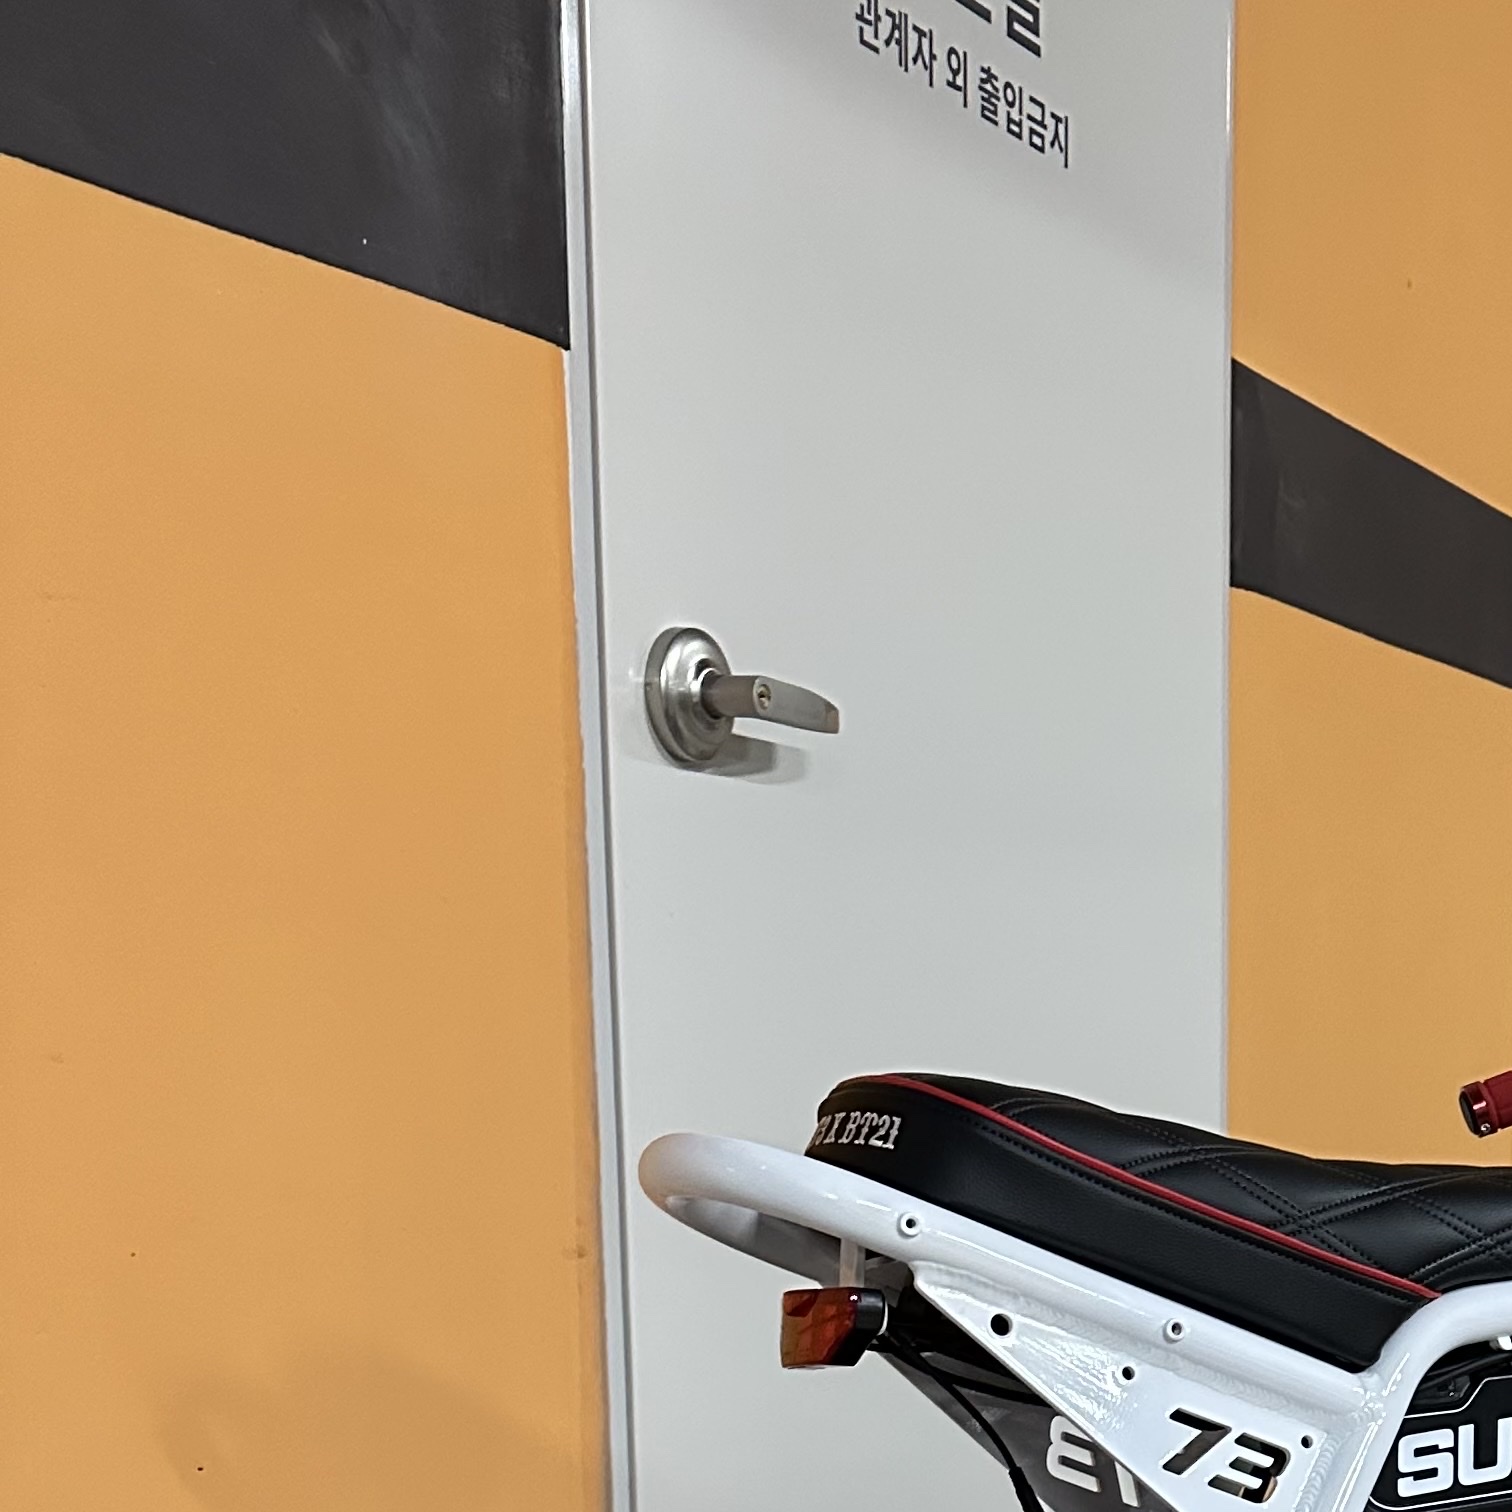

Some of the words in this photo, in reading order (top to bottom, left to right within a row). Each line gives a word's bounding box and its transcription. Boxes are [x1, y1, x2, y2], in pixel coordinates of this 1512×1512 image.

[855, 0, 937, 88] 관계자
[945, 46, 969, 108] 외
[977, 66, 1070, 169] 출입금지
[837, 1110, 902, 1150] BT21
[1162, 1406, 1292, 1504] 73
